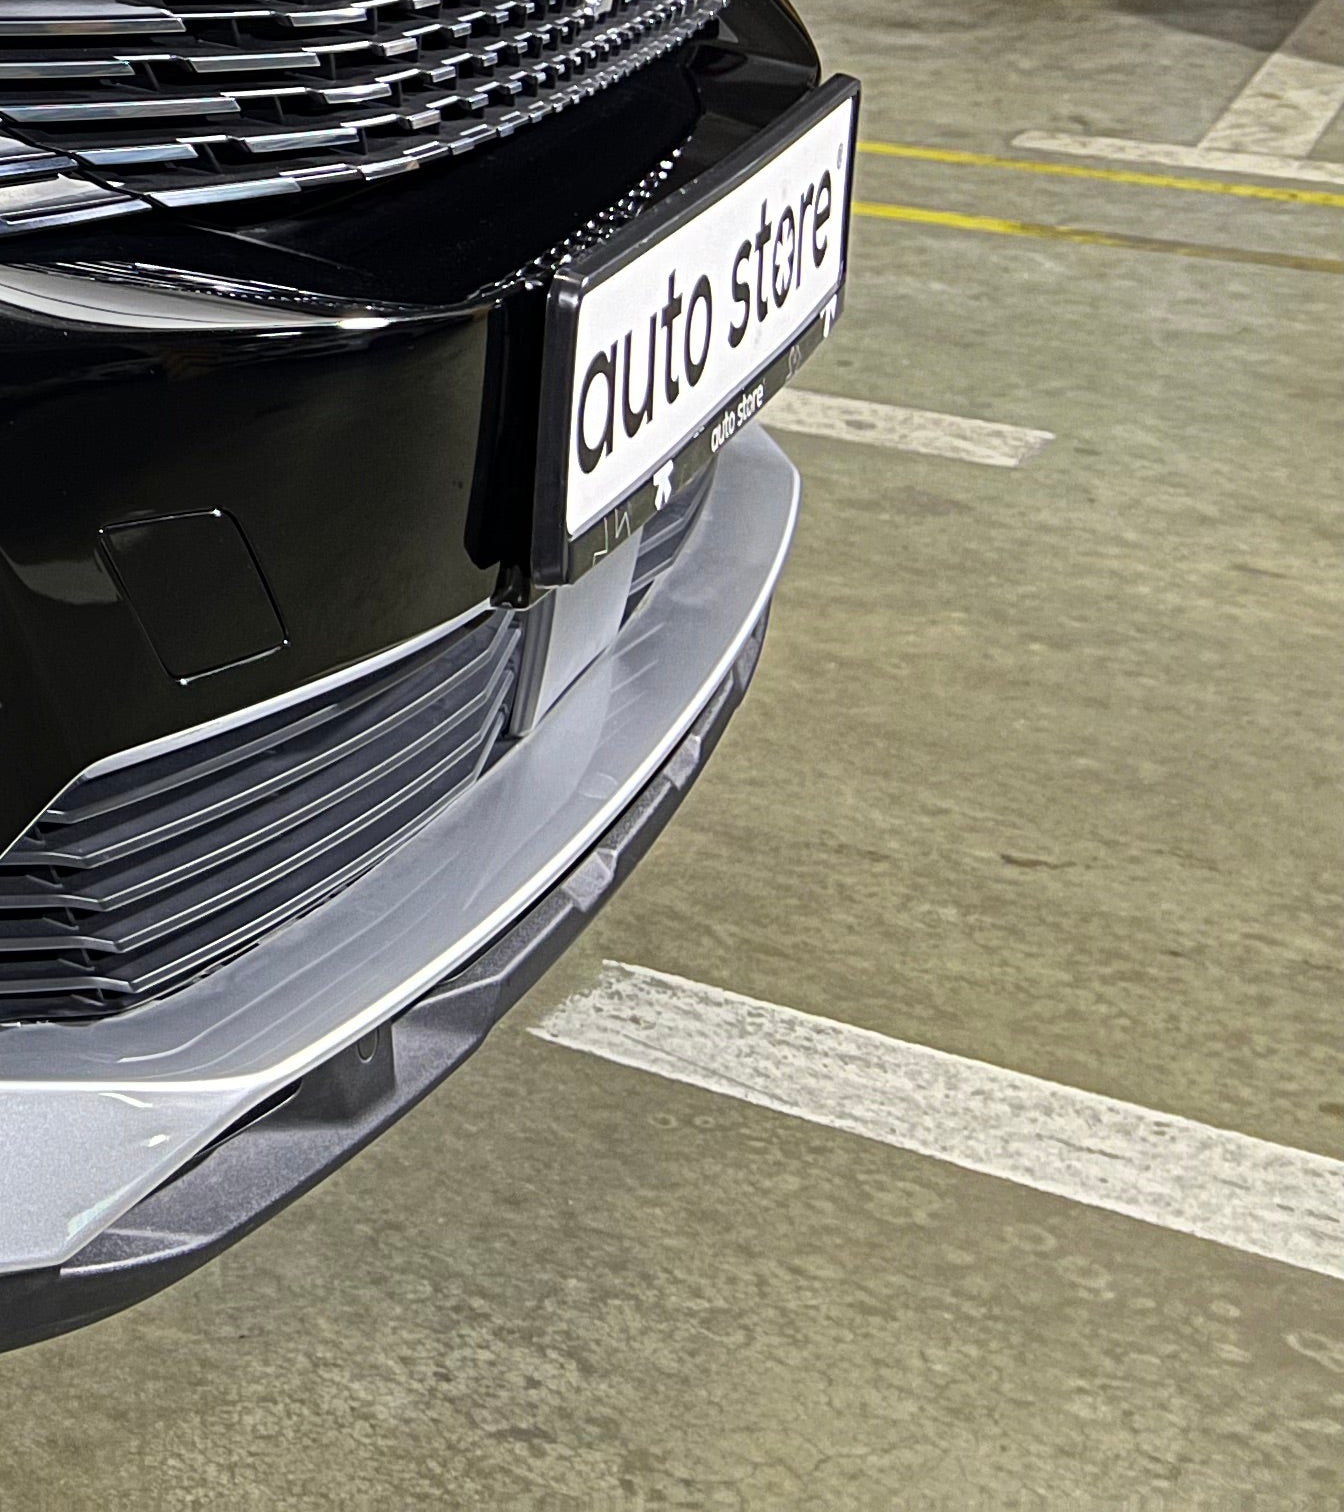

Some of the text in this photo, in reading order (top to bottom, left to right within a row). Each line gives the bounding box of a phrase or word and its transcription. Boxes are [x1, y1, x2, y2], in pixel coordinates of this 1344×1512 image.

[576, 170, 833, 474] auto store
[710, 383, 764, 453] auto store
